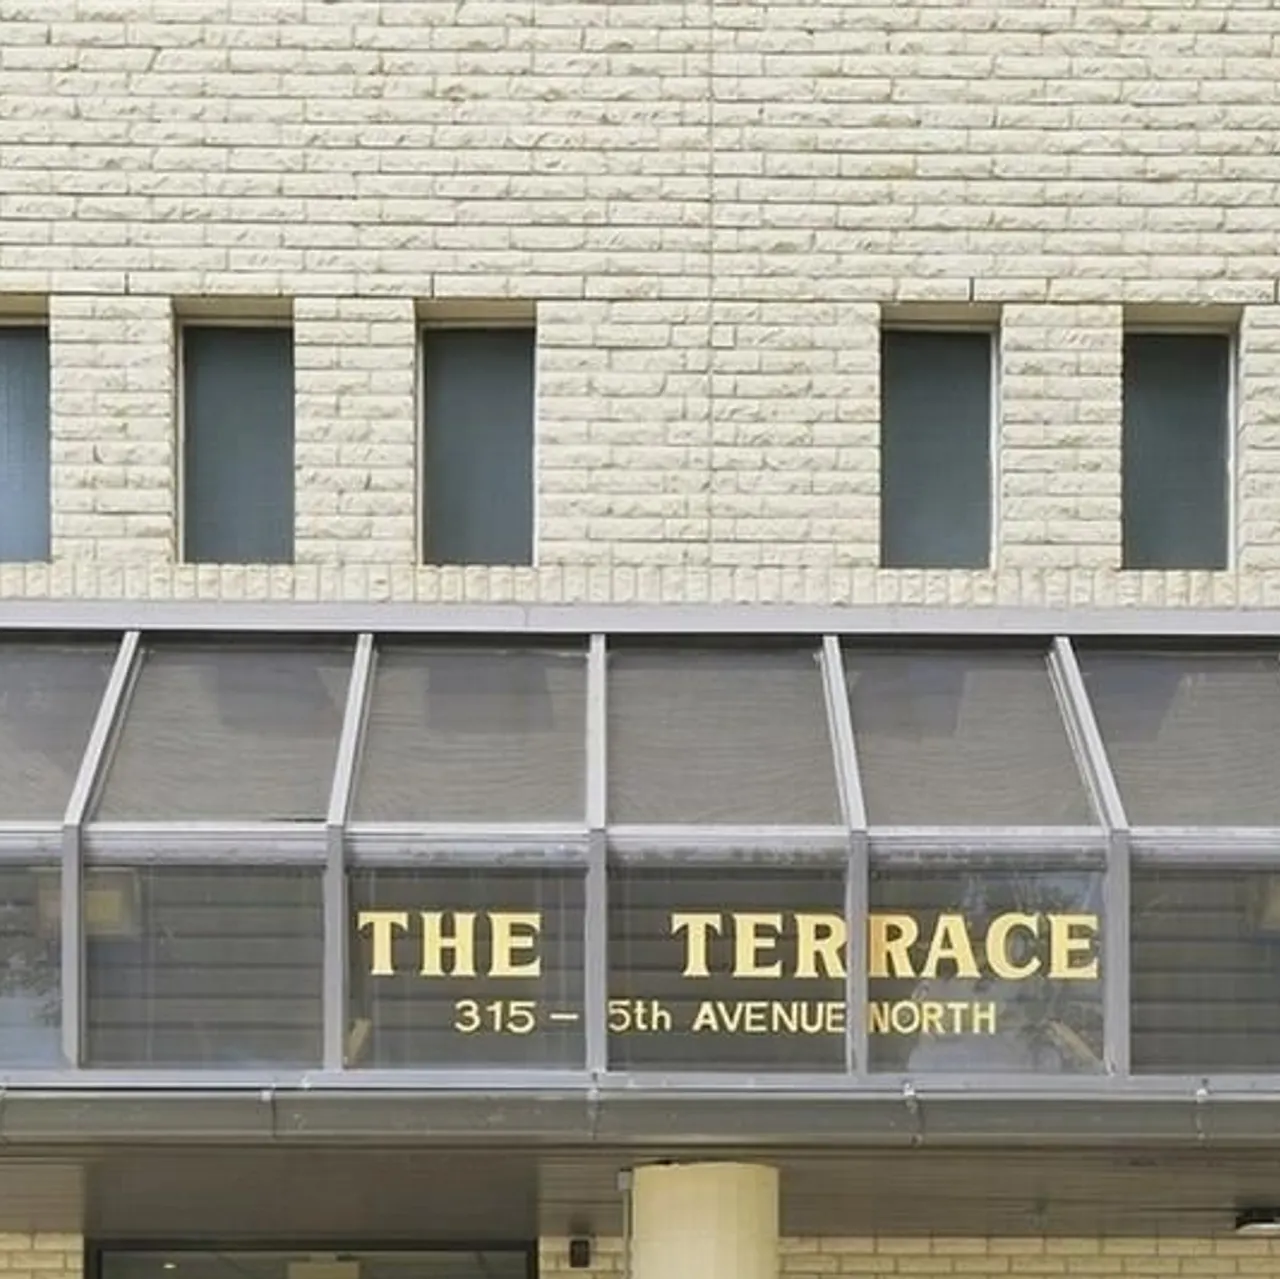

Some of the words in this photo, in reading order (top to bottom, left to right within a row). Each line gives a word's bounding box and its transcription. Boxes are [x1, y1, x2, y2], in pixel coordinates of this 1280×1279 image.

[357, 911, 541, 977] THE
[671, 912, 1099, 978] TERRACE
[454, 1000, 536, 1033] 315
[608, 1000, 671, 1031] 5th
[692, 1001, 847, 1031] AVENUE
[867, 1001, 996, 1033] NORTH
